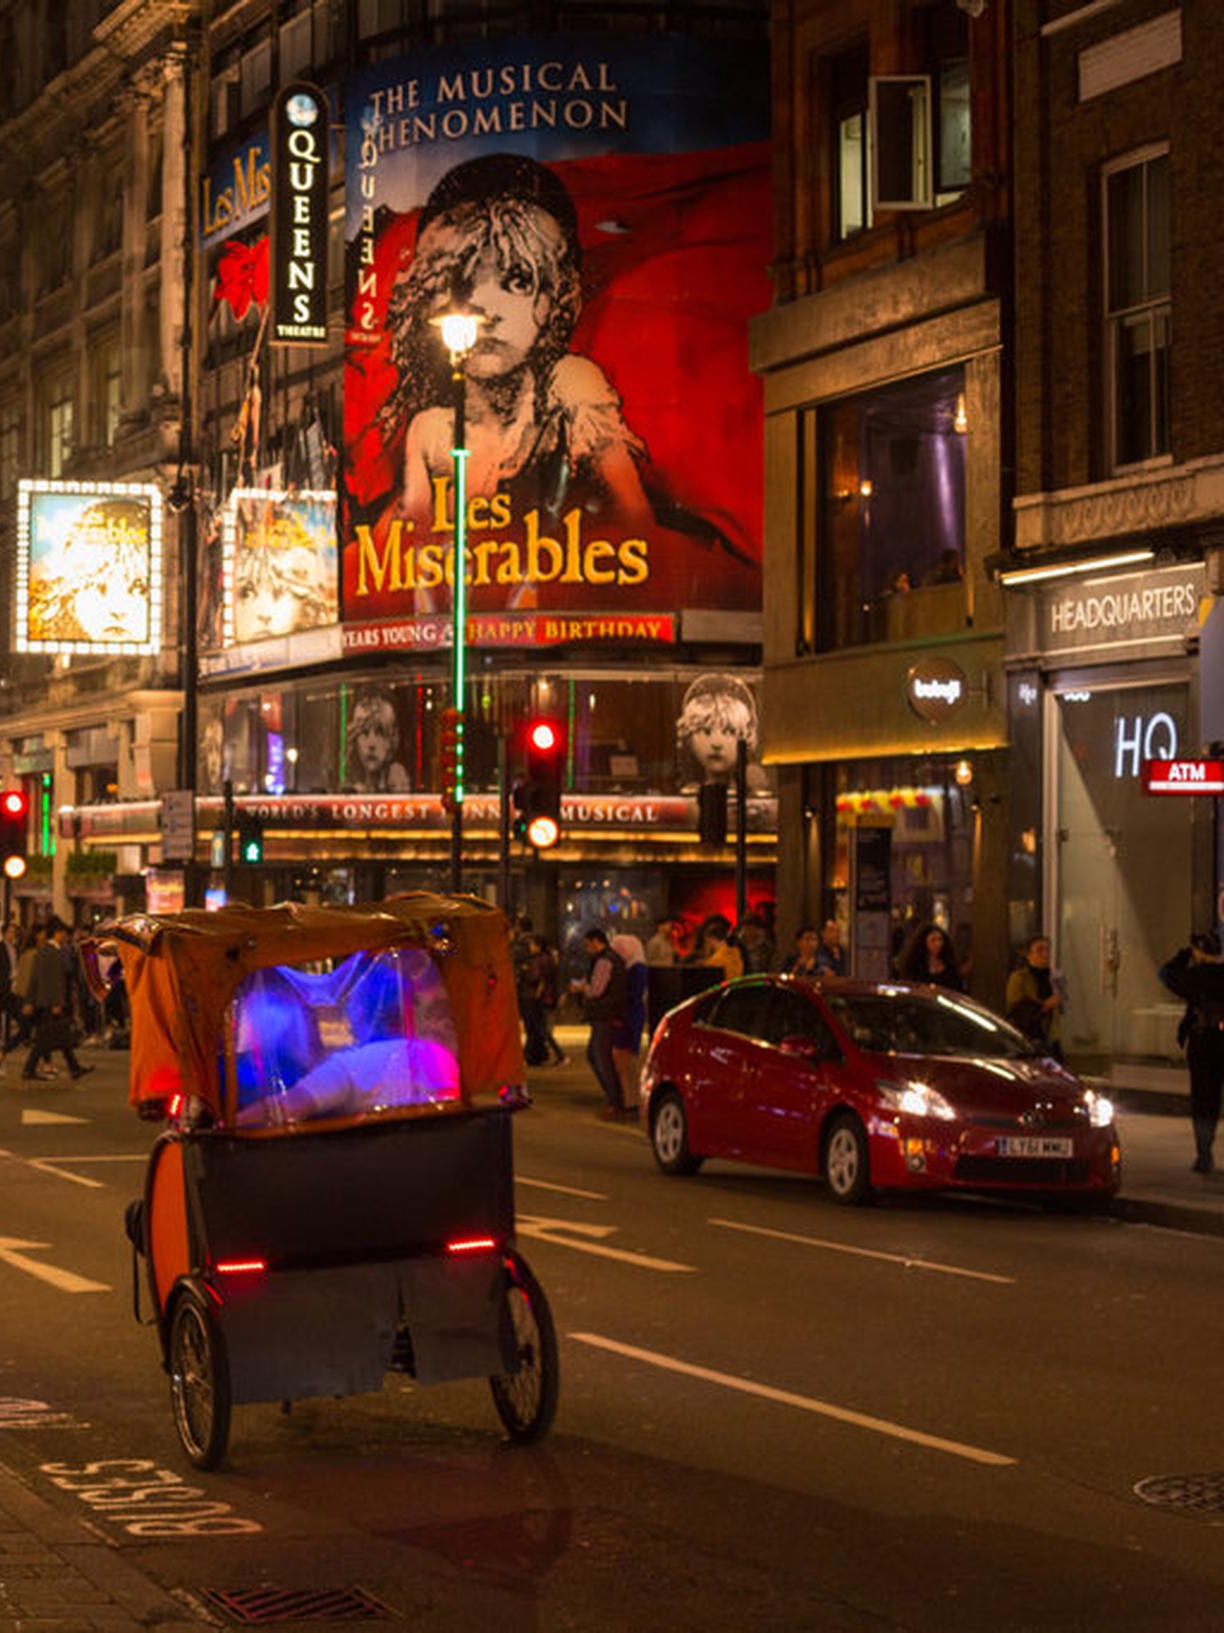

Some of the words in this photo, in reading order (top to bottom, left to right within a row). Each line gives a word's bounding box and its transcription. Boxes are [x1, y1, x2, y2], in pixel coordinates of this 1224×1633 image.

[369, 79, 419, 119] THE
[436, 61, 617, 103] MUSICAL
[203, 178, 233, 235] Les
[288, 130, 322, 323] QUEENS
[431, 476, 511, 533] Les
[381, 622, 437, 645] YOUNG
[468, 621, 536, 641] HAPPY
[544, 620, 662, 640] BIRTHDAY
[1051, 584, 1195, 632] HEADQUARTERS
[1115, 712, 1177, 777] HQ
[1168, 763, 1206, 780] ATM
[332, 802, 430, 820] LONGEST
[560, 802, 658, 822] MUSICAL
